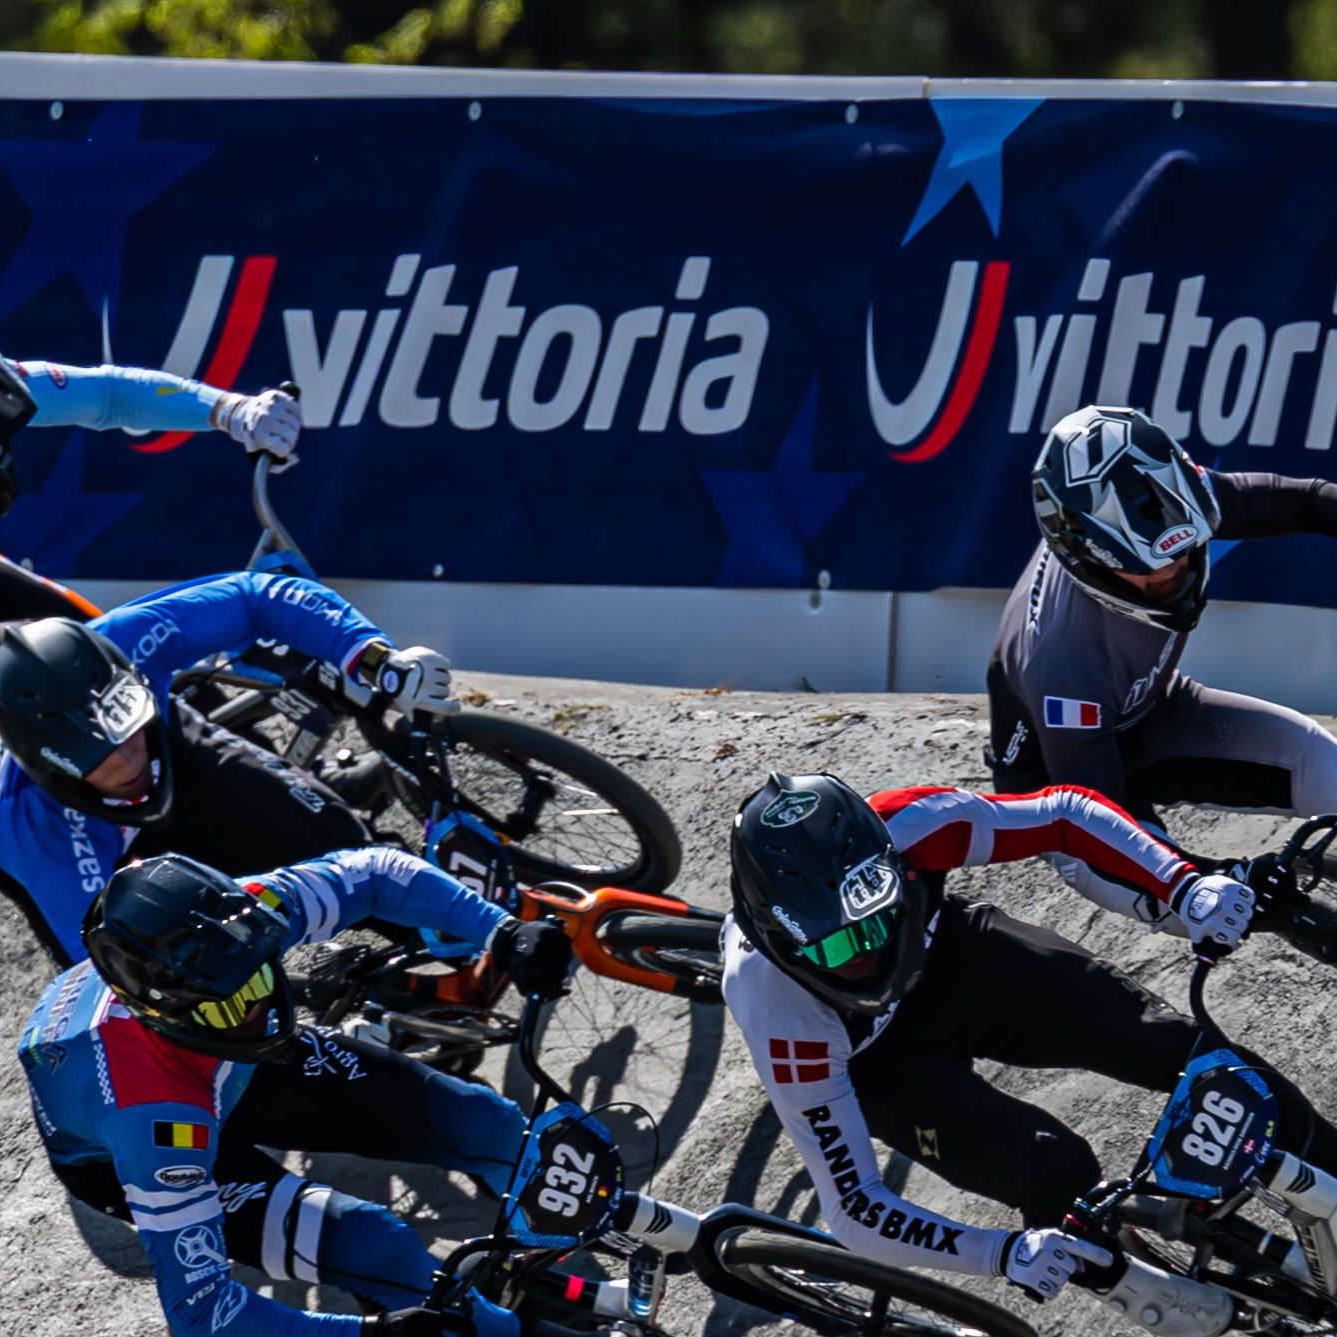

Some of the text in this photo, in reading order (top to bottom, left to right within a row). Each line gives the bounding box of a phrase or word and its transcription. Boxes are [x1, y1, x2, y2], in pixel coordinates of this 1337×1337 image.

[283, 253, 769, 434] vittoria
[1158, 528, 1195, 553] BELL
[322, 1039, 370, 1083] Agro
[1181, 1090, 1246, 1167] 826
[537, 1142, 596, 1217] 932
